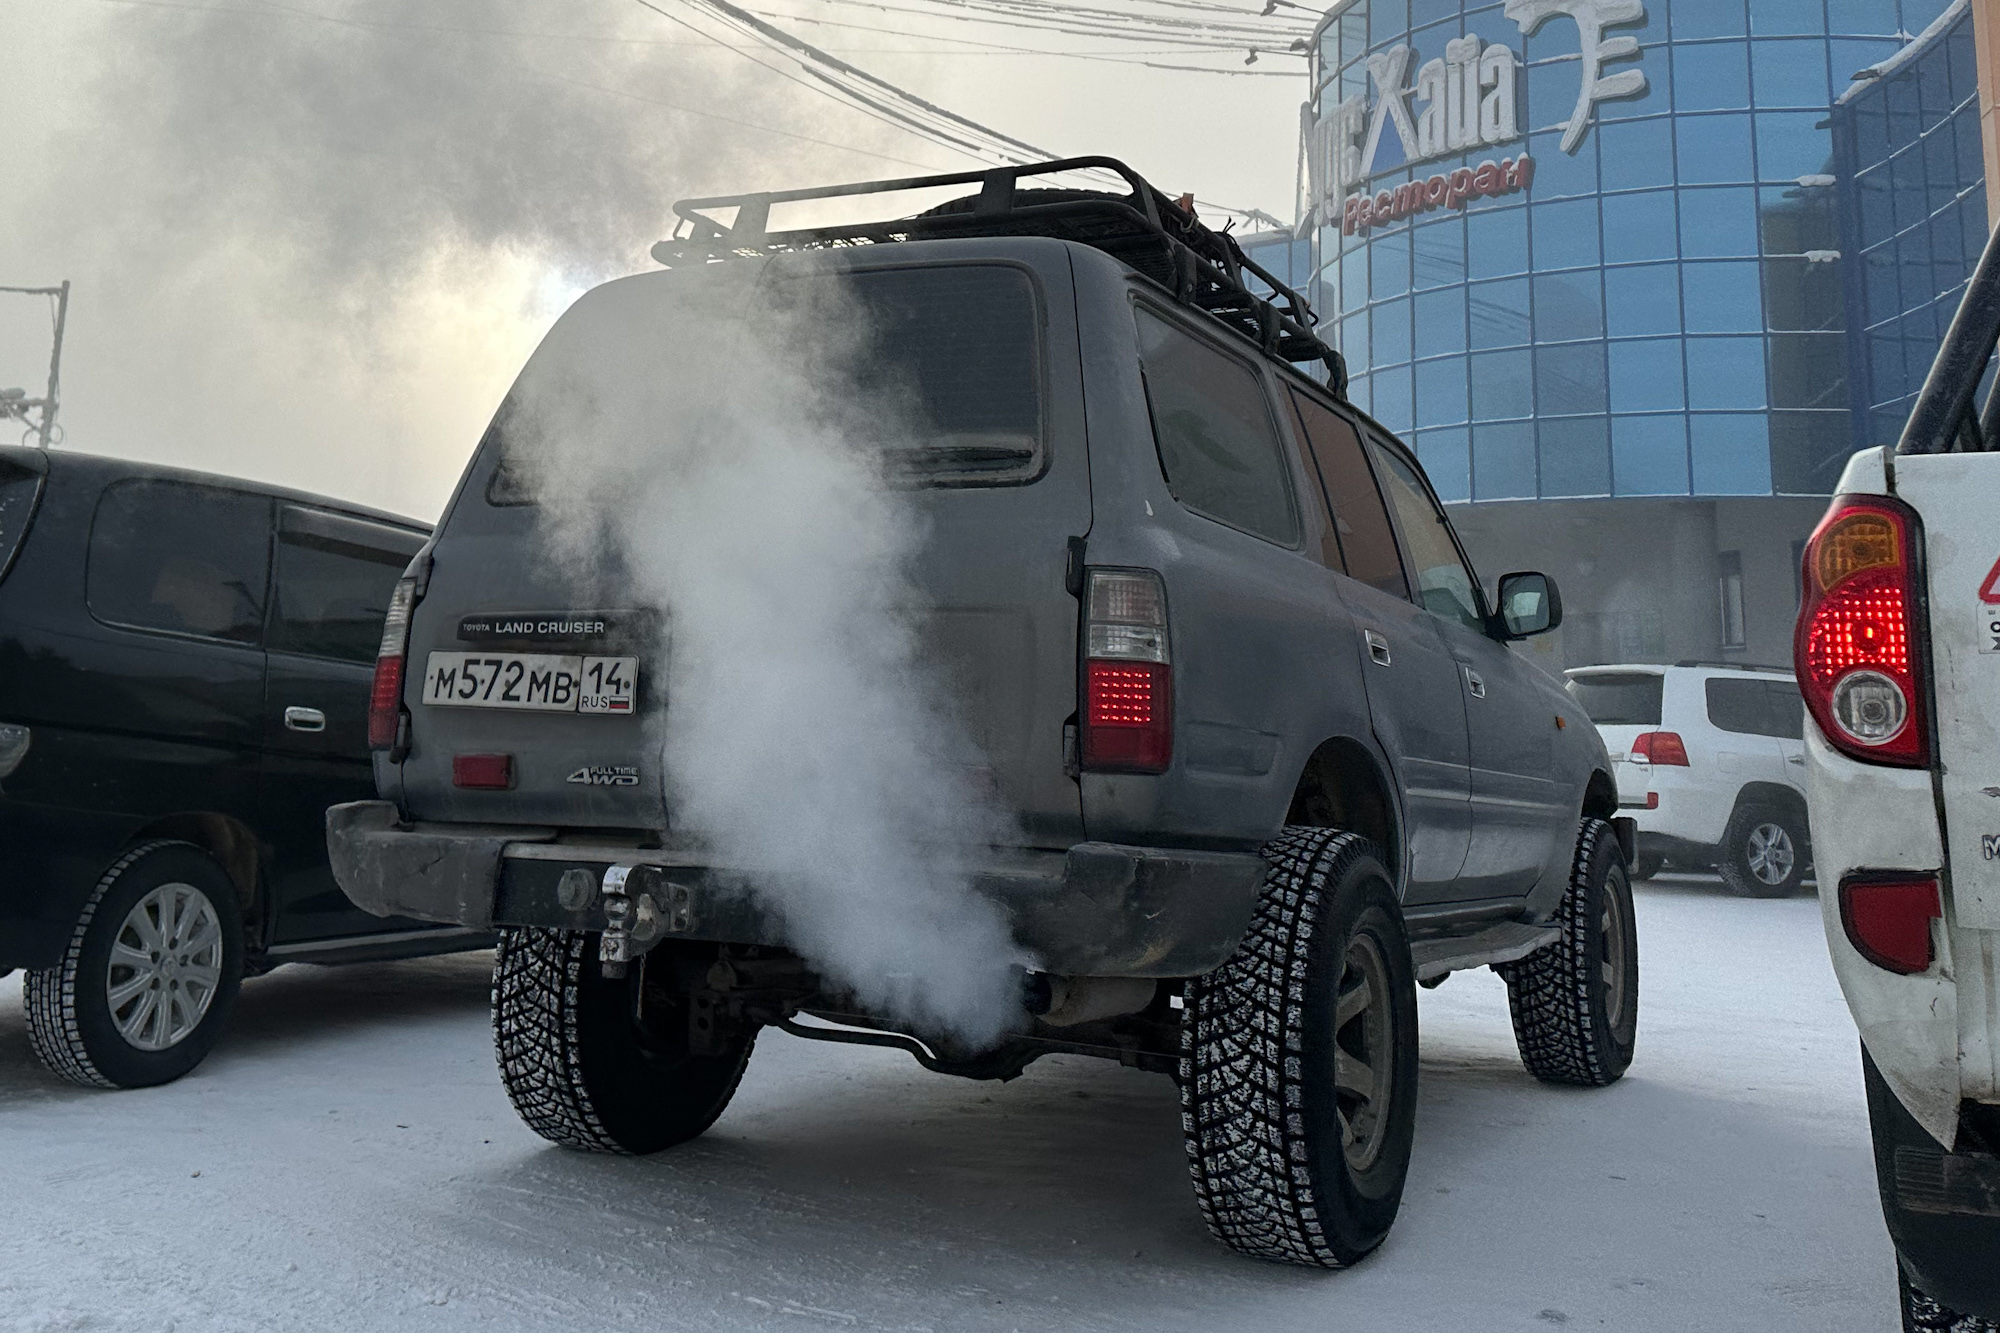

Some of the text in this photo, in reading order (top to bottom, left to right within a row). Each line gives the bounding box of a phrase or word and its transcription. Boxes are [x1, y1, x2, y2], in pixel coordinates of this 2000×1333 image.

[462, 621, 605, 634] TOYOTA LAND CRUISER
[588, 662, 622, 695] 14
[581, 695, 608, 709] RUS
[565, 767, 639, 786] 4WD
